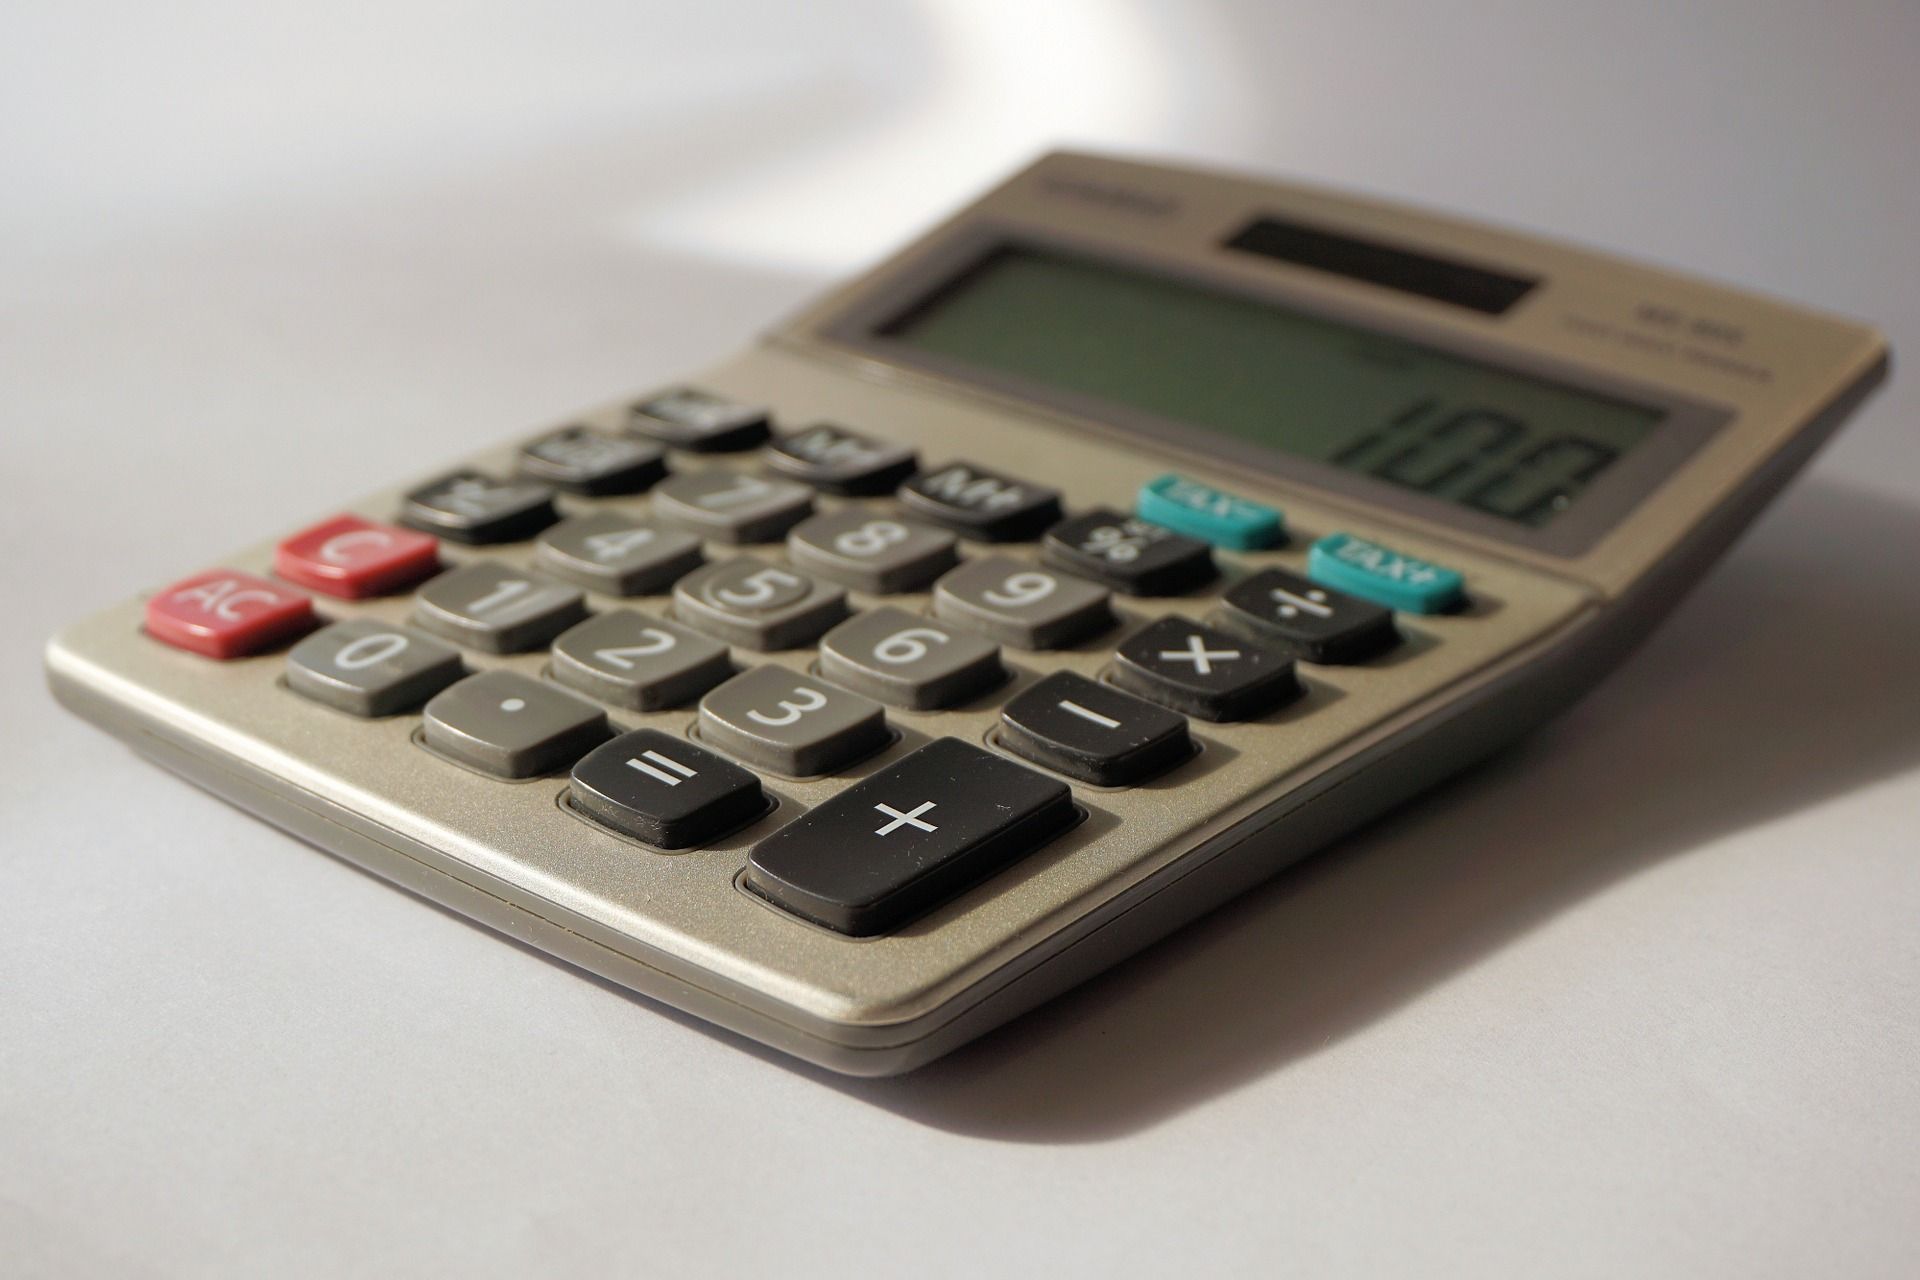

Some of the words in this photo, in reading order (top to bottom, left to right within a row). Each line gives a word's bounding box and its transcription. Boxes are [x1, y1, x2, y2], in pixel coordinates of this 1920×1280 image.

[702, 475, 769, 507] 7
[322, 529, 392, 563] C
[584, 528, 654, 560] 4
[835, 520, 907, 556] 8
[176, 579, 278, 622] AC
[467, 579, 529, 613] 1
[719, 568, 800, 603] 5
[982, 572, 1057, 607] 9
[335, 633, 407, 670] 0
[595, 628, 676, 669] 2
[873, 628, 949, 663] 6
[747, 687, 827, 727] 3
